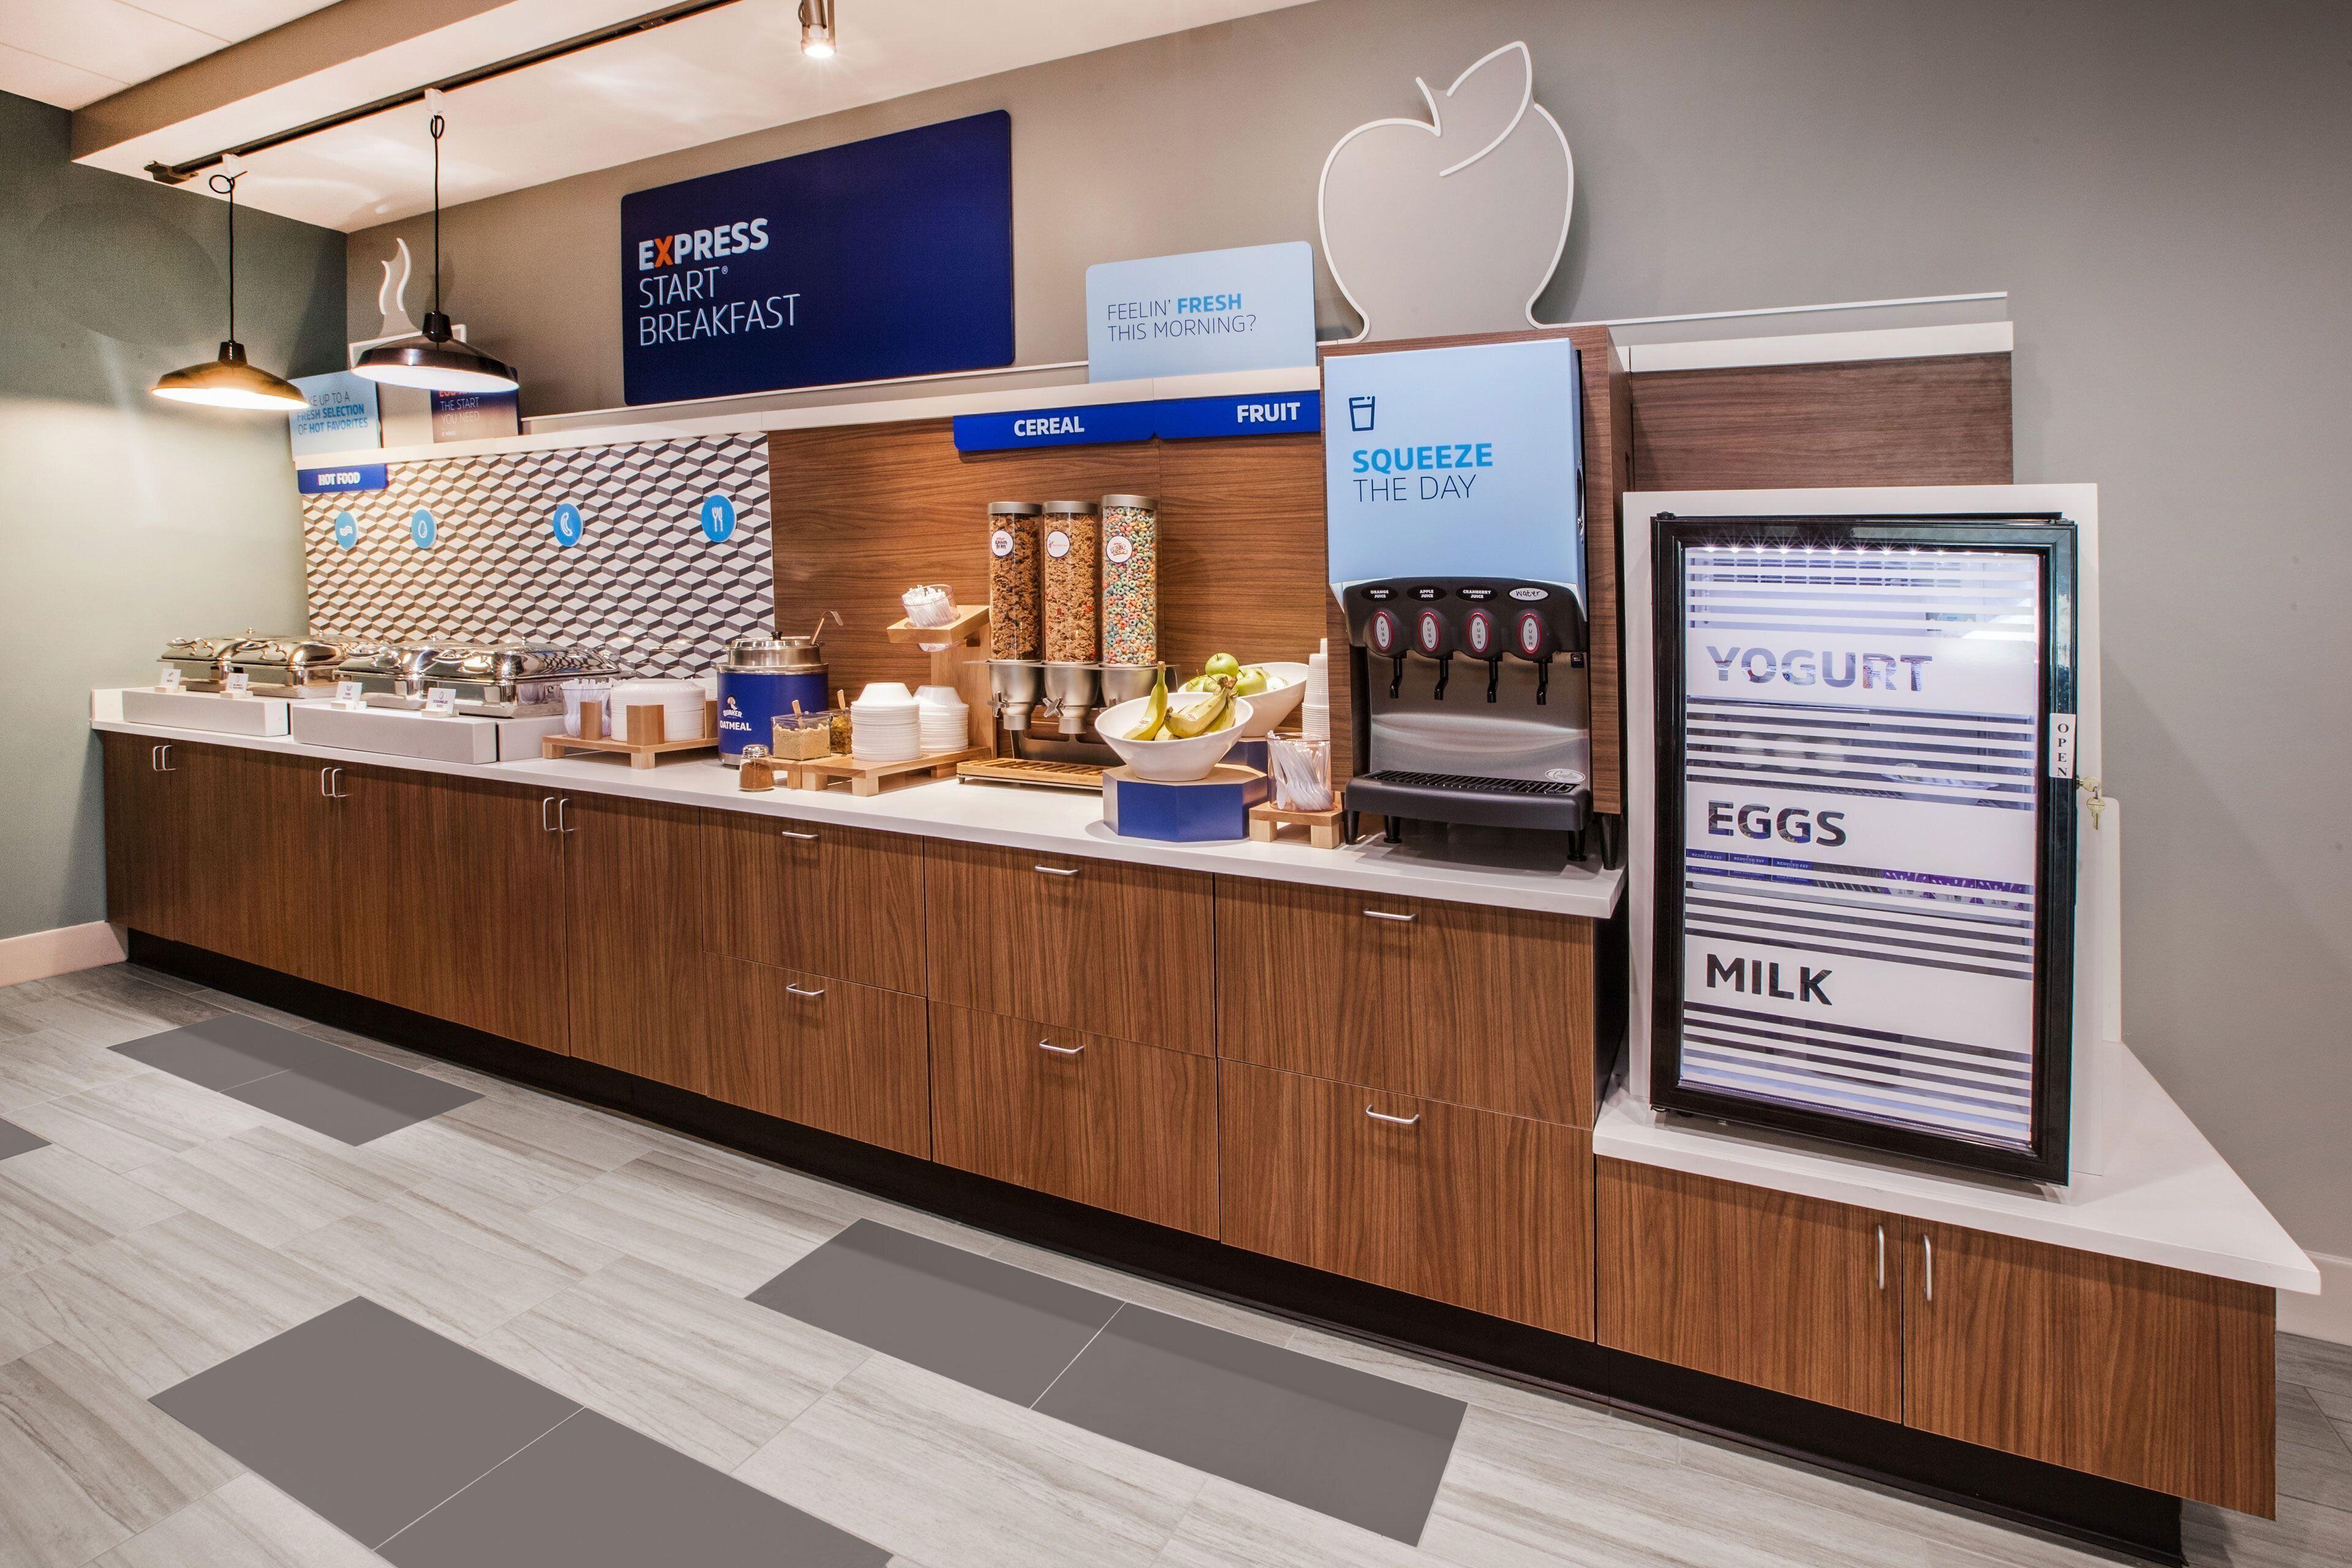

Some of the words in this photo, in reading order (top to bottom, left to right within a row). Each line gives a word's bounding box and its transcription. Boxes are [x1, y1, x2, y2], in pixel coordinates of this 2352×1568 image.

[639, 218, 769, 271] EXPRESS
[1177, 293, 1242, 314] FRESH
[640, 293, 801, 346] BREAKFAST
[1107, 323, 1147, 341] THIS
[1155, 314, 1256, 338] MORNING?
[319, 394, 330, 405] UP
[331, 392, 342, 404] TO
[344, 391, 350, 402] A
[440, 400, 455, 411] THE
[457, 397, 480, 410] START
[297, 409, 320, 421] FRESH
[323, 404, 365, 418] SELECTION
[441, 413, 457, 424] YOU
[459, 411, 480, 423] NEED
[1237, 402, 1301, 423] FRUIT
[298, 423, 307, 435] OF
[309, 422, 325, 433] HOT
[326, 417, 368, 431] FAVORITES
[1014, 416, 1085, 437] CEREAL
[1352, 443, 1493, 474] SQUEEZE
[318, 473, 336, 486] HOT
[336, 472, 361, 484] FOOD
[1353, 477, 1407, 502] THE
[1420, 474, 1477, 500] DAY
[1706, 646, 1932, 692] YOGURT
[723, 709, 742, 718] QUAKER
[720, 720, 752, 731] OATMEAL
[2057, 723, 2069, 777] OPEN
[1708, 800, 1846, 846] EGGS
[1707, 954, 1833, 1005] MILK
